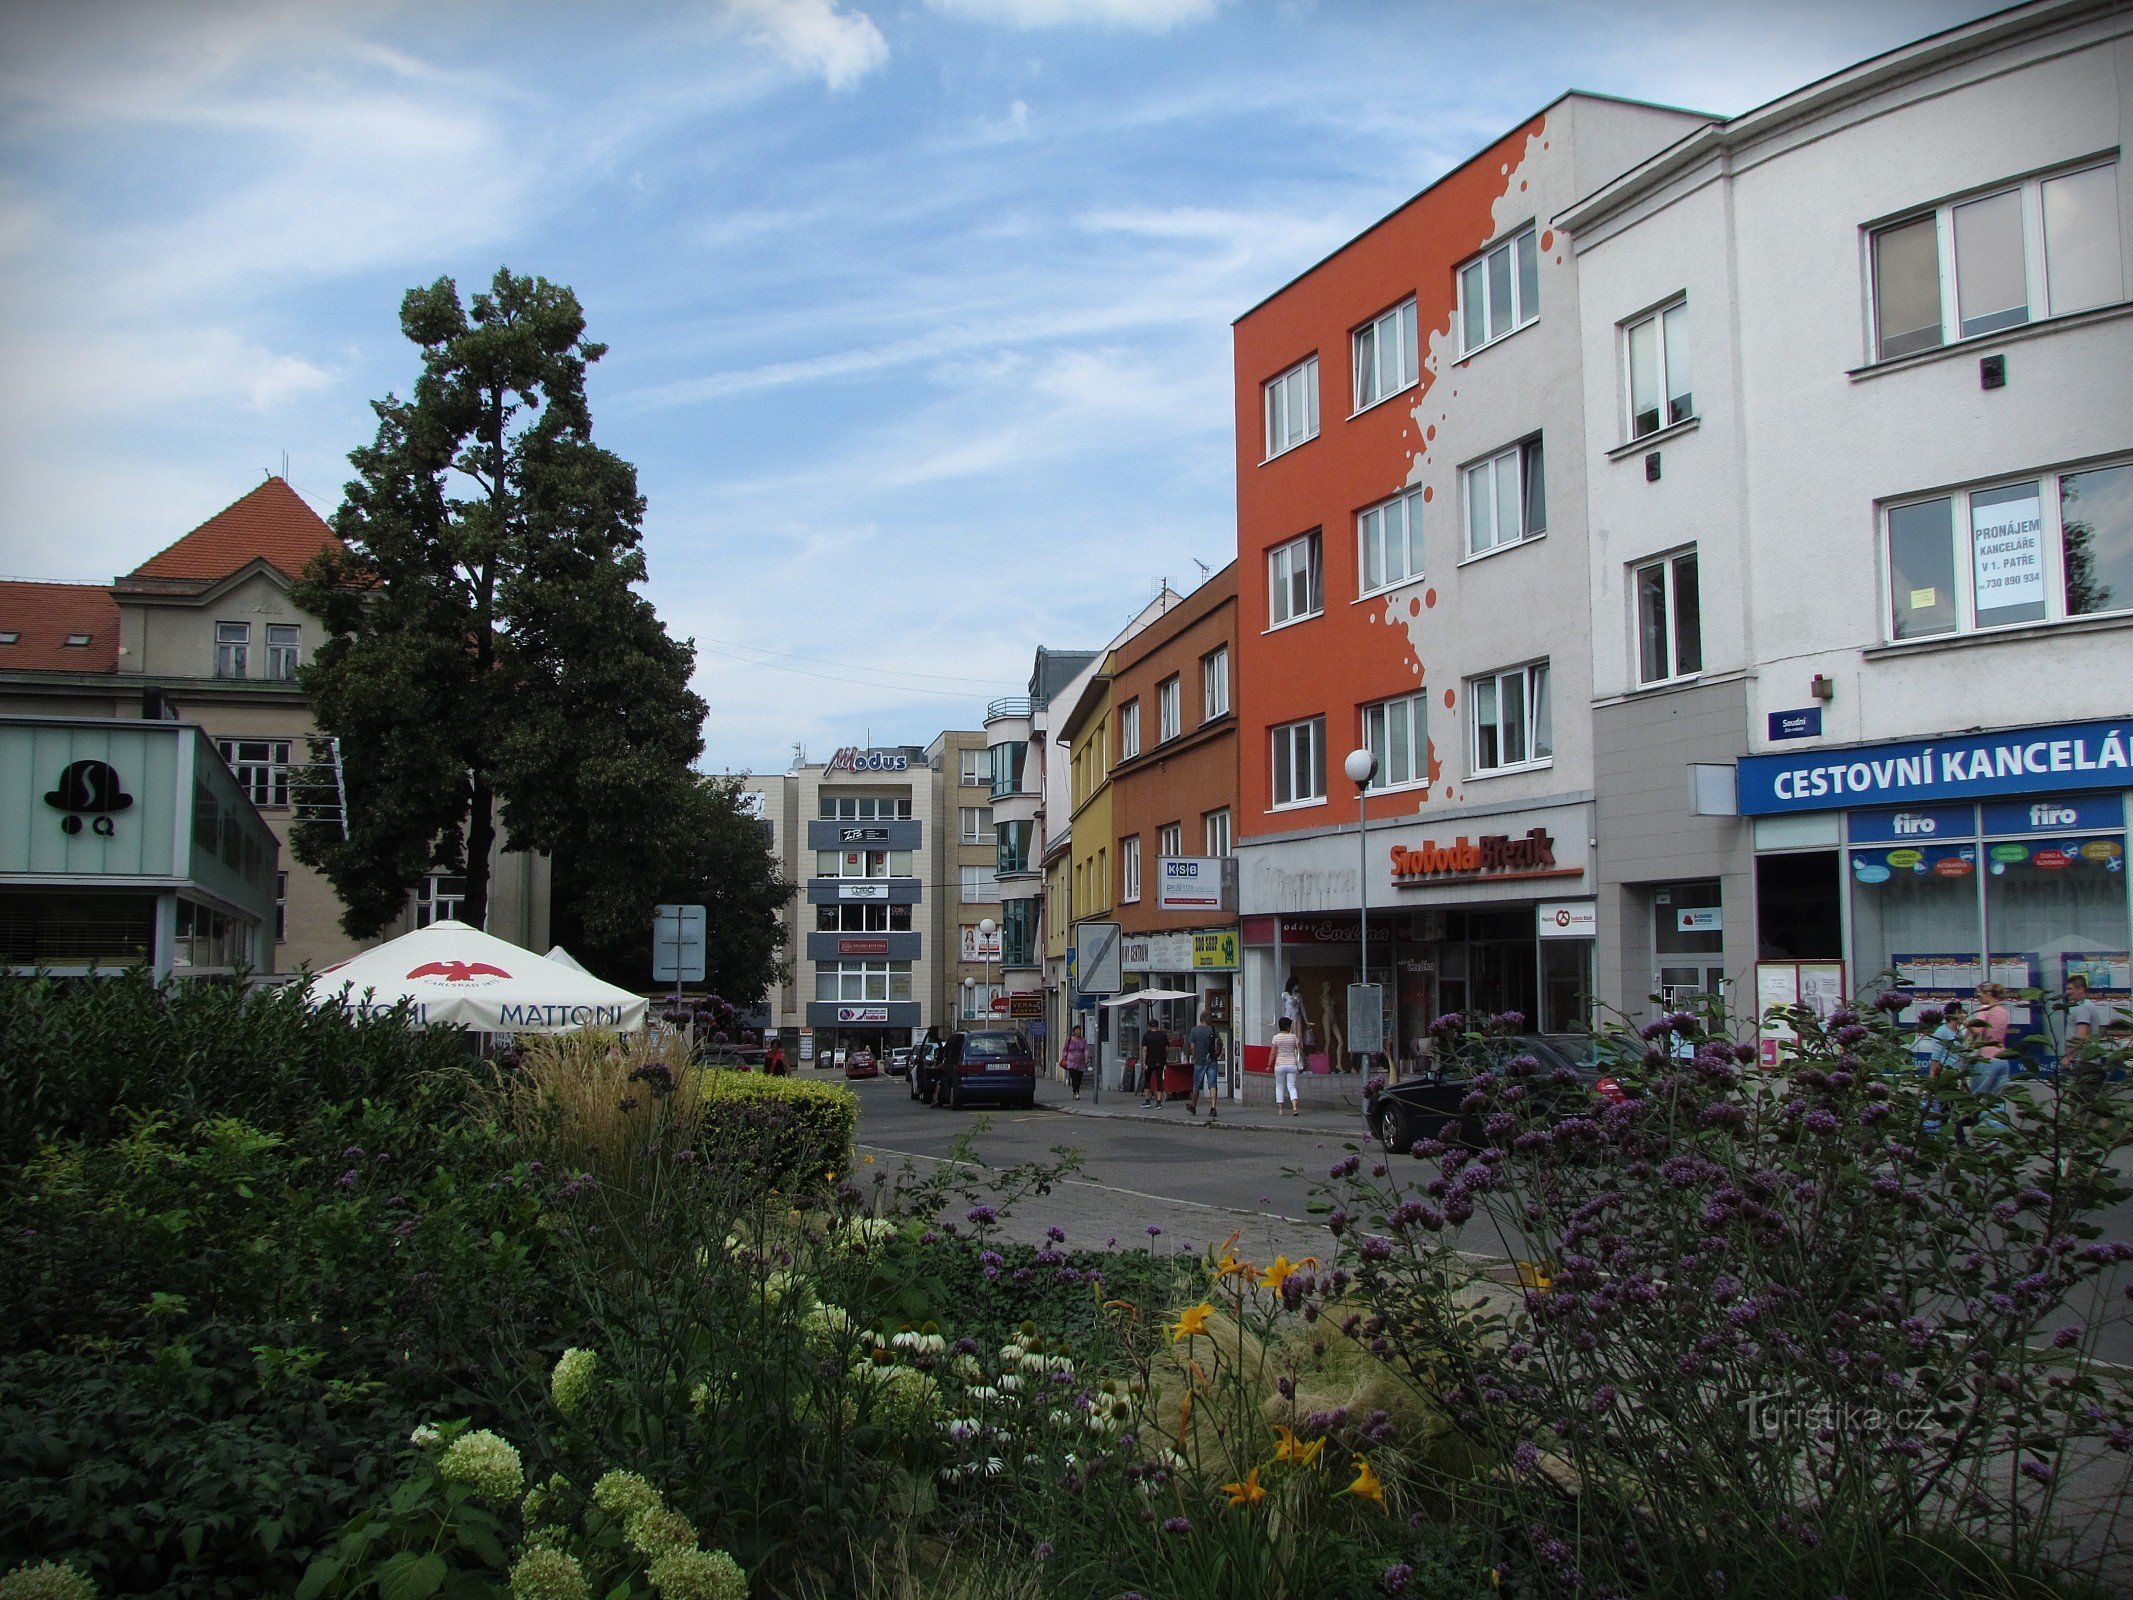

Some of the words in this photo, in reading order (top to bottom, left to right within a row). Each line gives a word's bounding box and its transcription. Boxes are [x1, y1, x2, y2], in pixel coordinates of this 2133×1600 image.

[1975, 518, 2040, 542] PRONÁJEM
[1979, 537, 2035, 557] KANCELÁŘE
[1981, 561, 1989, 572] V
[1991, 561, 2000, 571] 1.
[2003, 553, 2035, 570] PATŘE
[1986, 577, 2002, 589] 730
[2004, 575, 2021, 586] 890
[2023, 572, 2040, 584] 934
[1782, 717, 1807, 728] Soudní
[822, 746, 907, 779] Modus
[1773, 747, 1934, 800] CESTOVNÍ
[1942, 729, 2133, 783] KANCELÁ
[1892, 812, 1936, 834] firo
[2029, 803, 2077, 826] firo
[1283, 922, 1317, 932] oděvy
[423, 978, 480, 988] CARLSBAD
[500, 1003, 623, 1027] MATTONI
